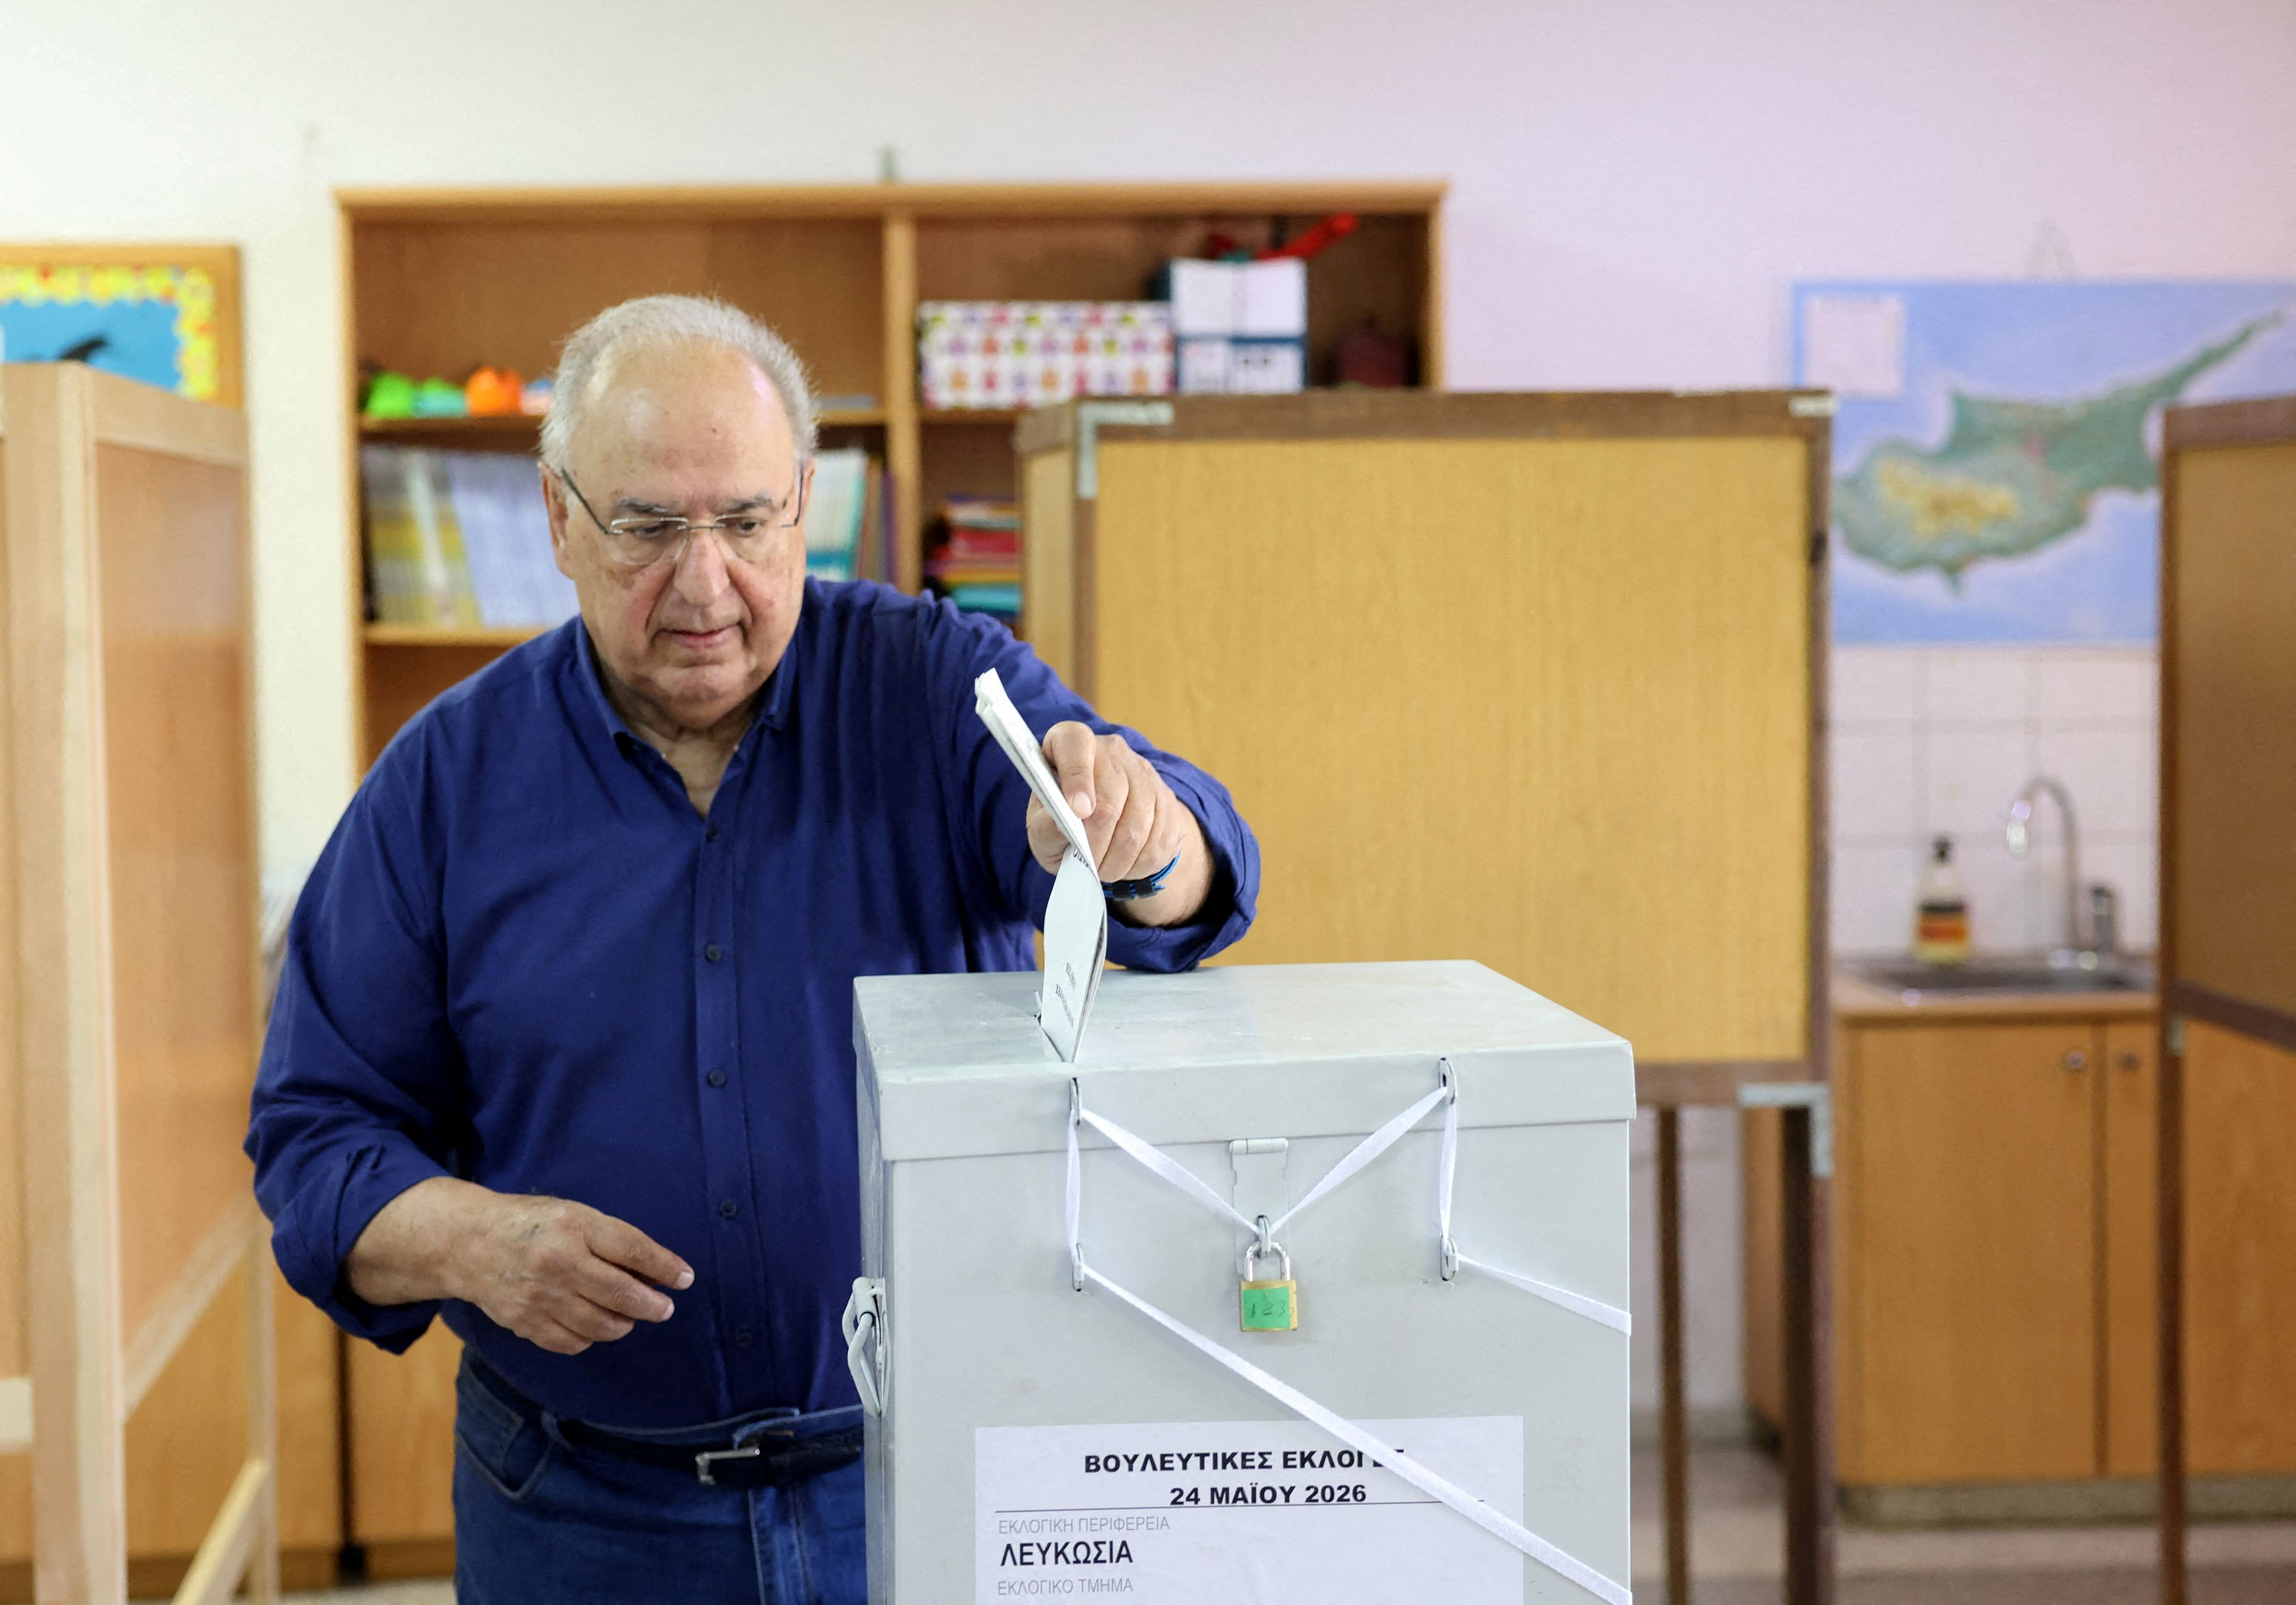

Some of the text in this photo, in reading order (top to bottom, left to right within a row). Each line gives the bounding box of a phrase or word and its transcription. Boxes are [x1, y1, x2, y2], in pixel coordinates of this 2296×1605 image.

[1084, 1449, 1404, 1473] ΒΟΥΛΕΥΤΙΚΕΣ ΕΚΛΟΓ
[1170, 1482, 1367, 1506] 24 ΜΑΪΟΥ 2026
[998, 1516, 1170, 1534] ΕΚΛΟΓΙΚΗ ΠΕΡΙΦΕΡΕΙΑ
[1000, 1540, 1134, 1566] ΛΕΥΚΩΣΙΑ
[998, 1577, 1134, 1596] ΕΚΛΟΓΙΚΟ ΤΜΗΜΑ
